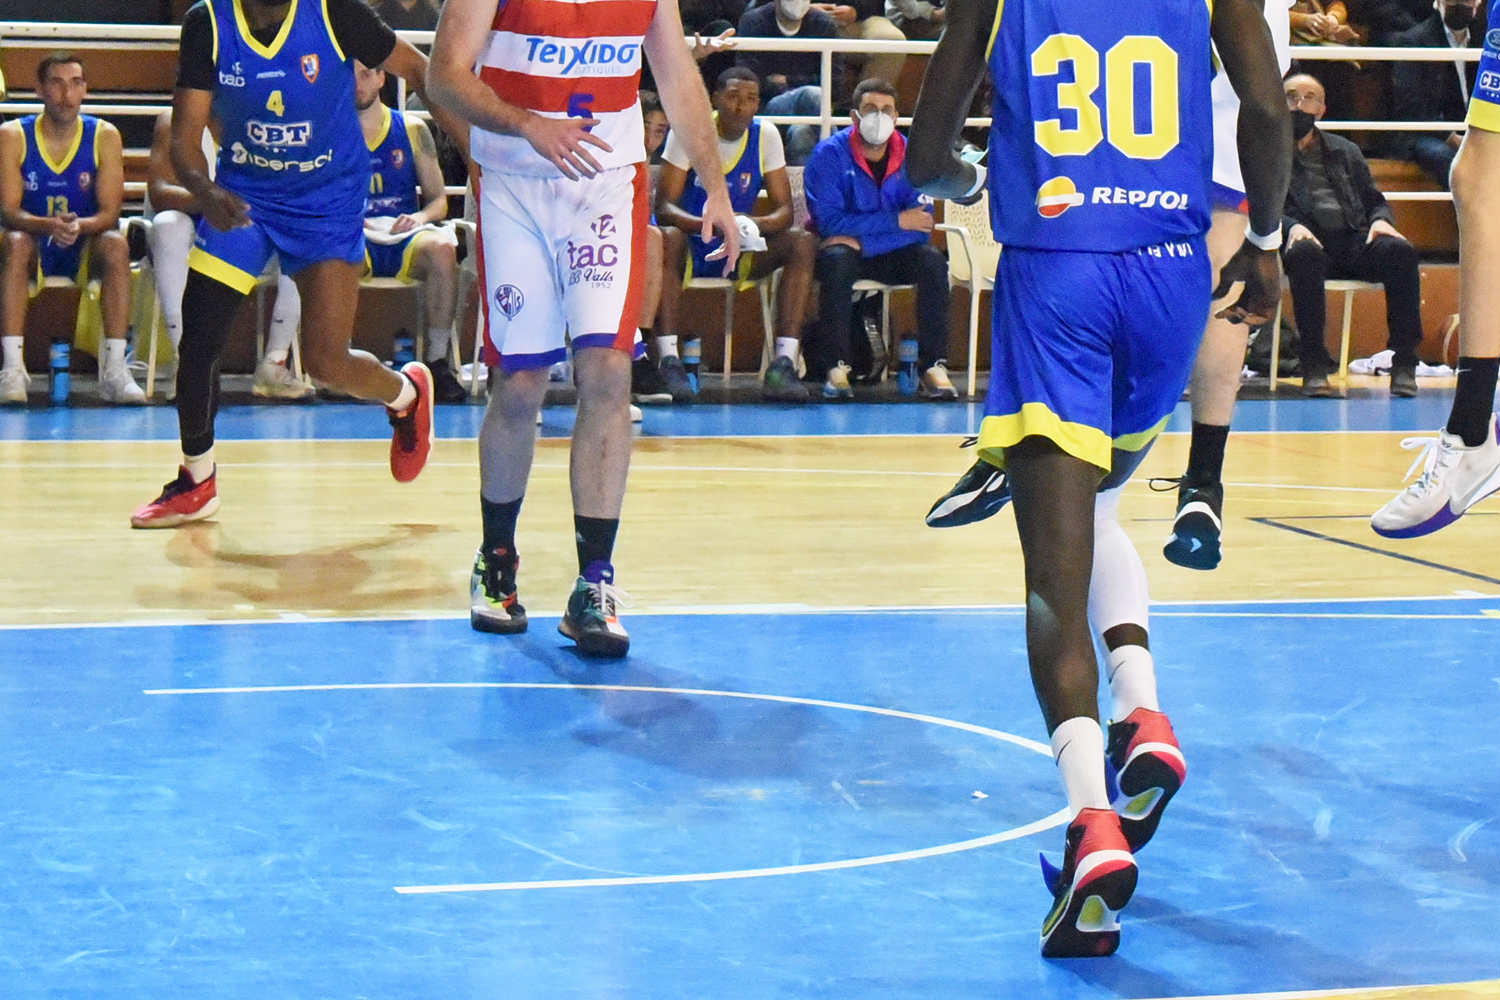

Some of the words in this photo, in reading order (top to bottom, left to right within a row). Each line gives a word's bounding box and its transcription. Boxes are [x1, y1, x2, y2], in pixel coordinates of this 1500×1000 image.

[219, 70, 246, 87] tac
[266, 90, 285, 117] 4
[1031, 33, 1180, 160] 30
[567, 93, 595, 133] 5
[247, 121, 311, 146] CBT
[1091, 186, 1189, 211] REPSOL
[567, 240, 619, 270] tac
[583, 268, 613, 282] Valls
